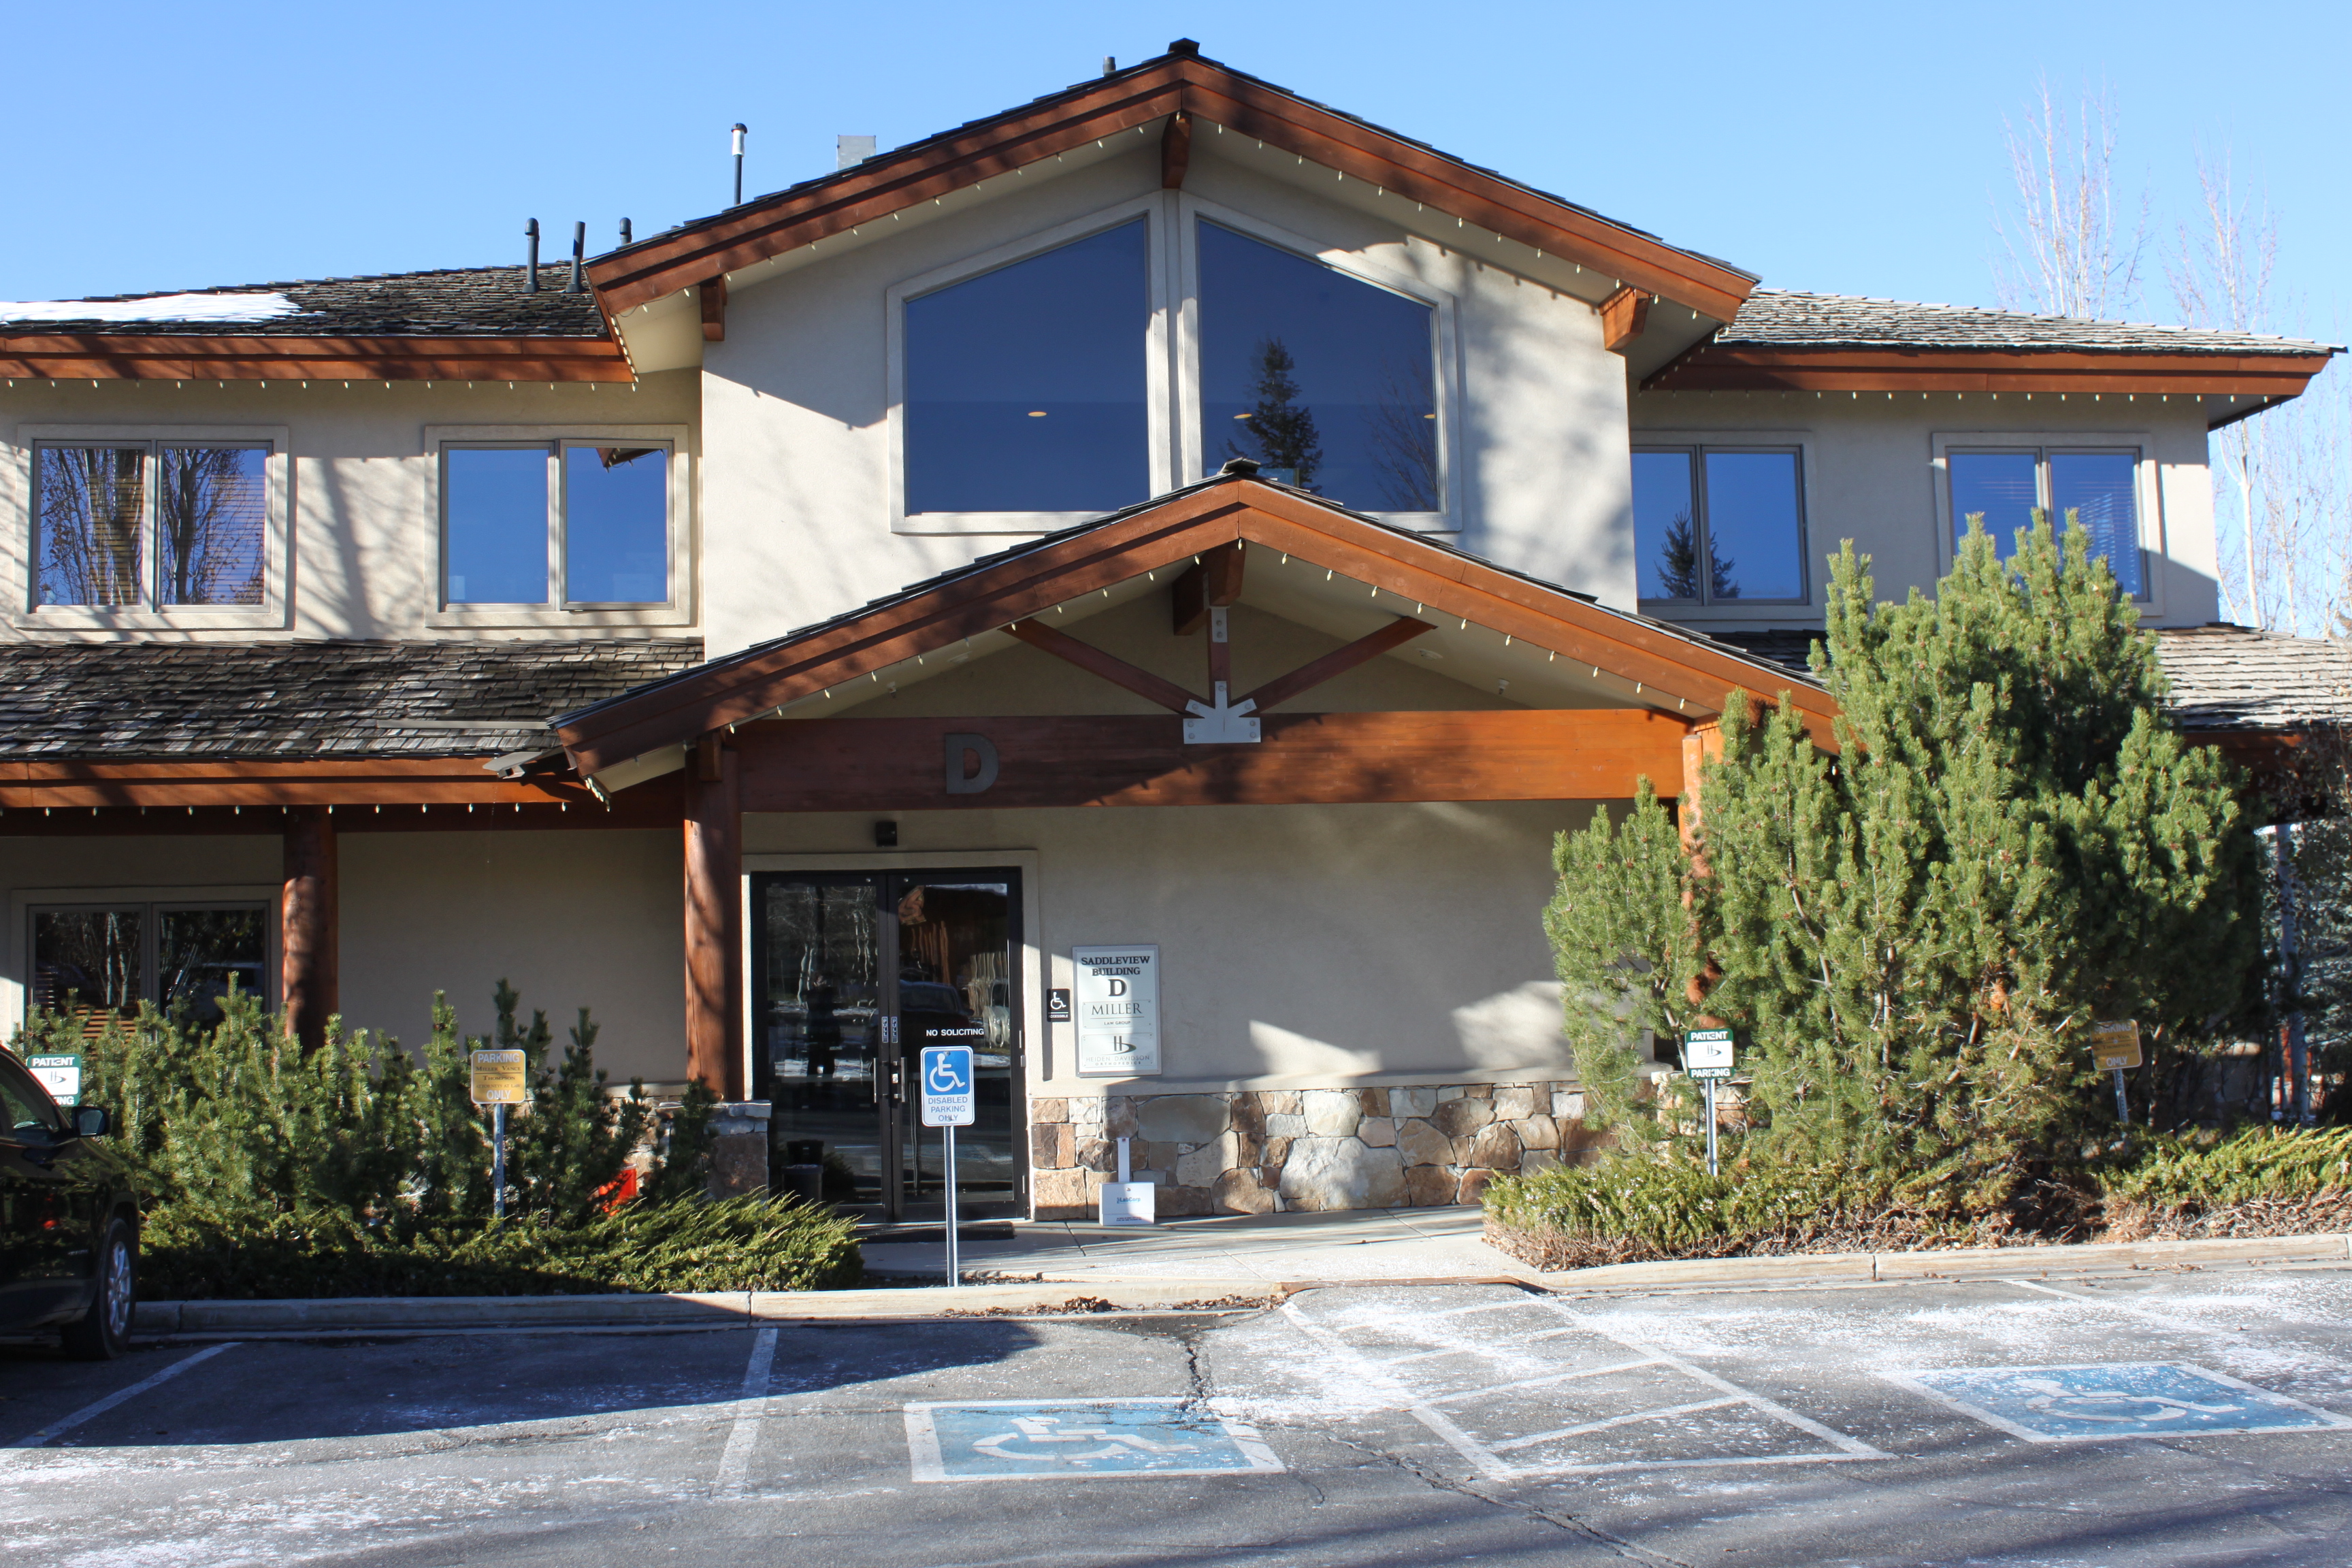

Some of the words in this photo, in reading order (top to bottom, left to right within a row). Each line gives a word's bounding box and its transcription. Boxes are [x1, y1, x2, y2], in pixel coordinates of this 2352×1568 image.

[945, 733, 999, 795] D
[1081, 956, 1151, 966] SADDLEVIEW
[1092, 966, 1141, 977] BUILDING
[1107, 979, 1128, 997] D
[1091, 1002, 1143, 1015] MILLER
[941, 1028, 985, 1036] SOLICITING
[1690, 1030, 1729, 1041] PATIENT
[32, 1056, 76, 1067] PATIENT
[478, 1052, 521, 1063] PARKING
[2106, 1056, 2128, 1067] ONLY
[1690, 1067, 1731, 1078] PARKING
[486, 1089, 512, 1100] ONLY
[928, 1096, 968, 1105] DISABLED
[930, 1105, 966, 1113] PARKING
[938, 1114, 959, 1122] ONLY
